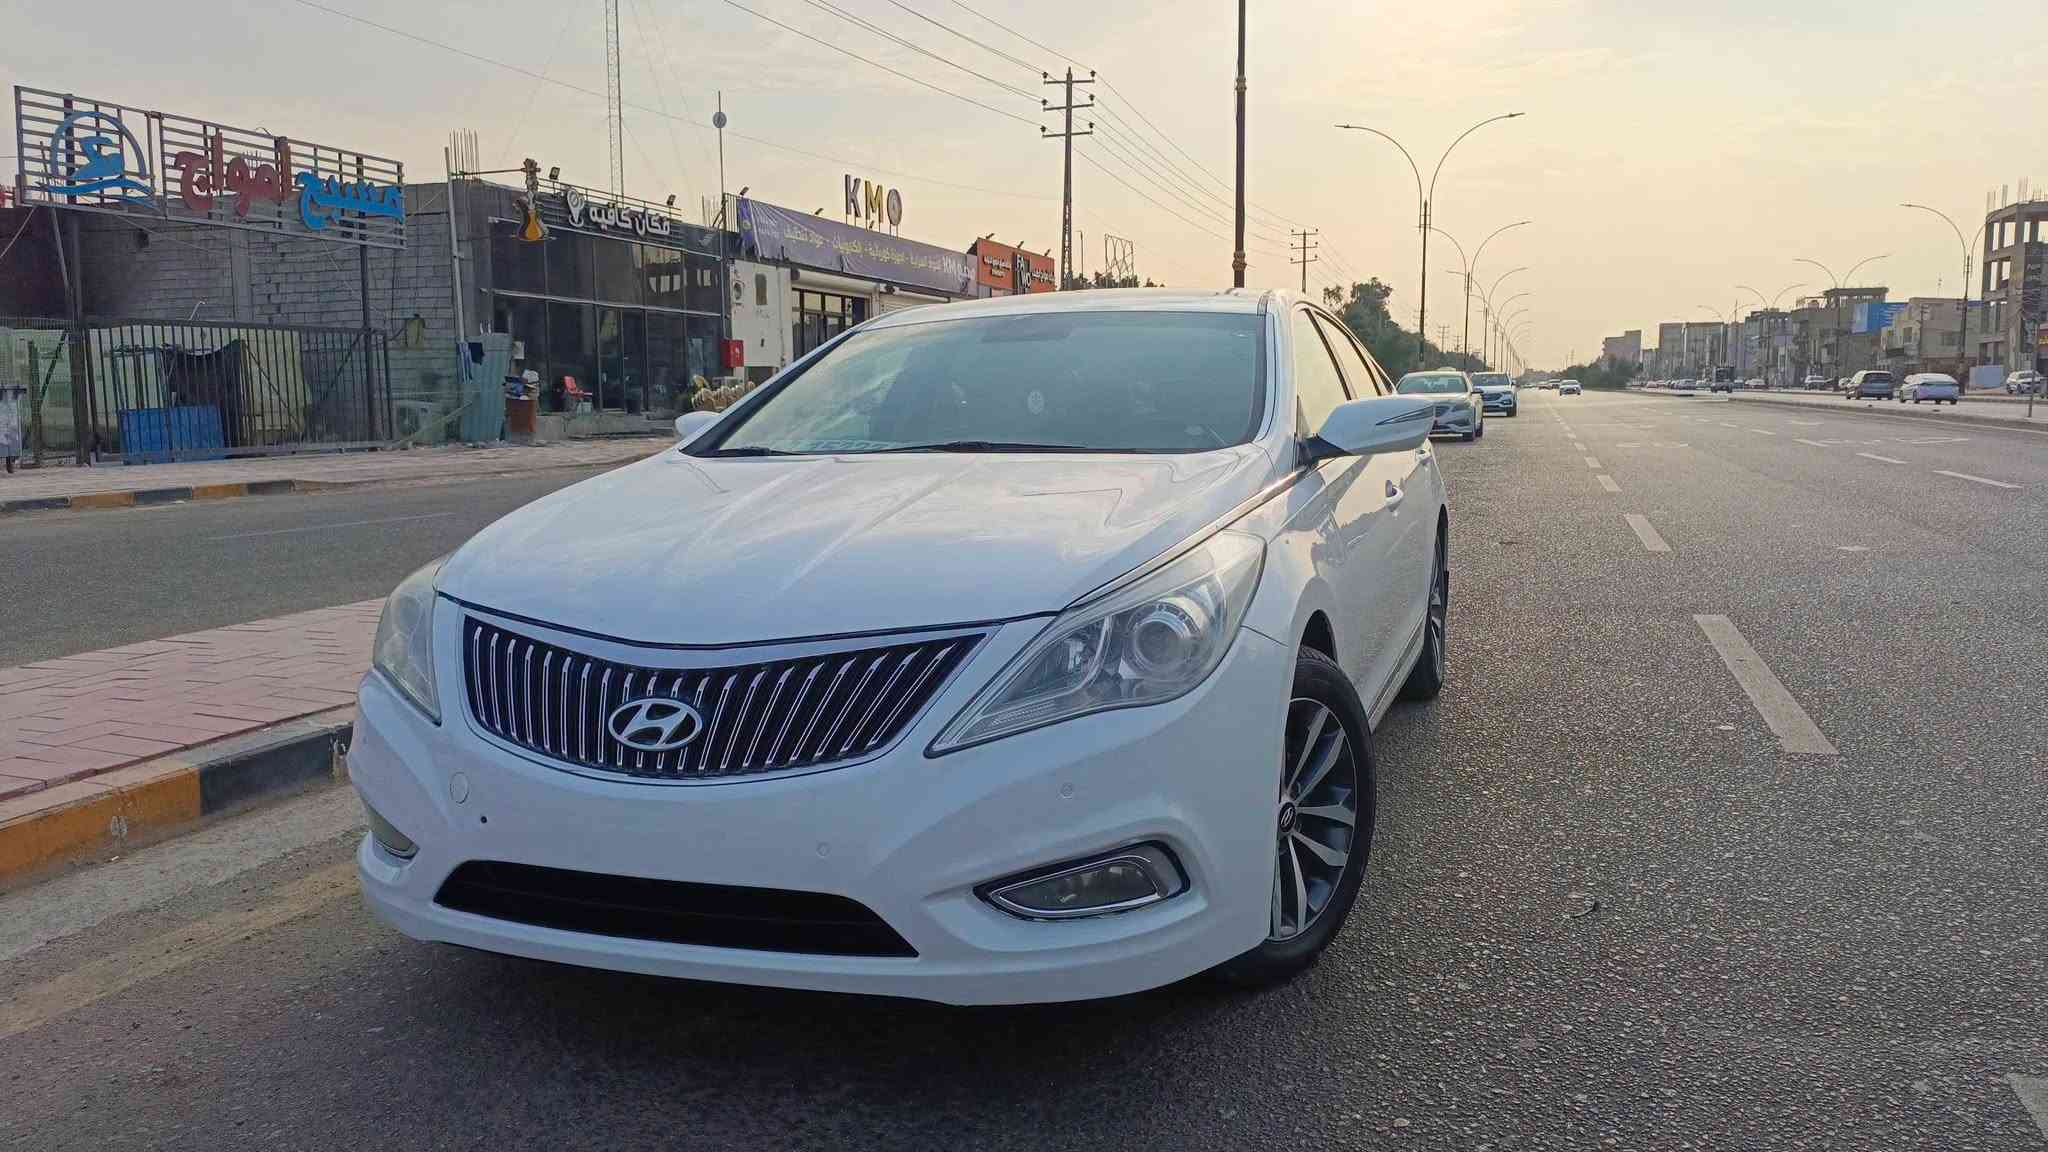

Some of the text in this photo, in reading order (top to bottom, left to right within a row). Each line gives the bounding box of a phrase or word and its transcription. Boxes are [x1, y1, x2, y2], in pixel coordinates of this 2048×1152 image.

[589, 204, 670, 236] مكان كافيه
[845, 174, 902, 226] KMO
